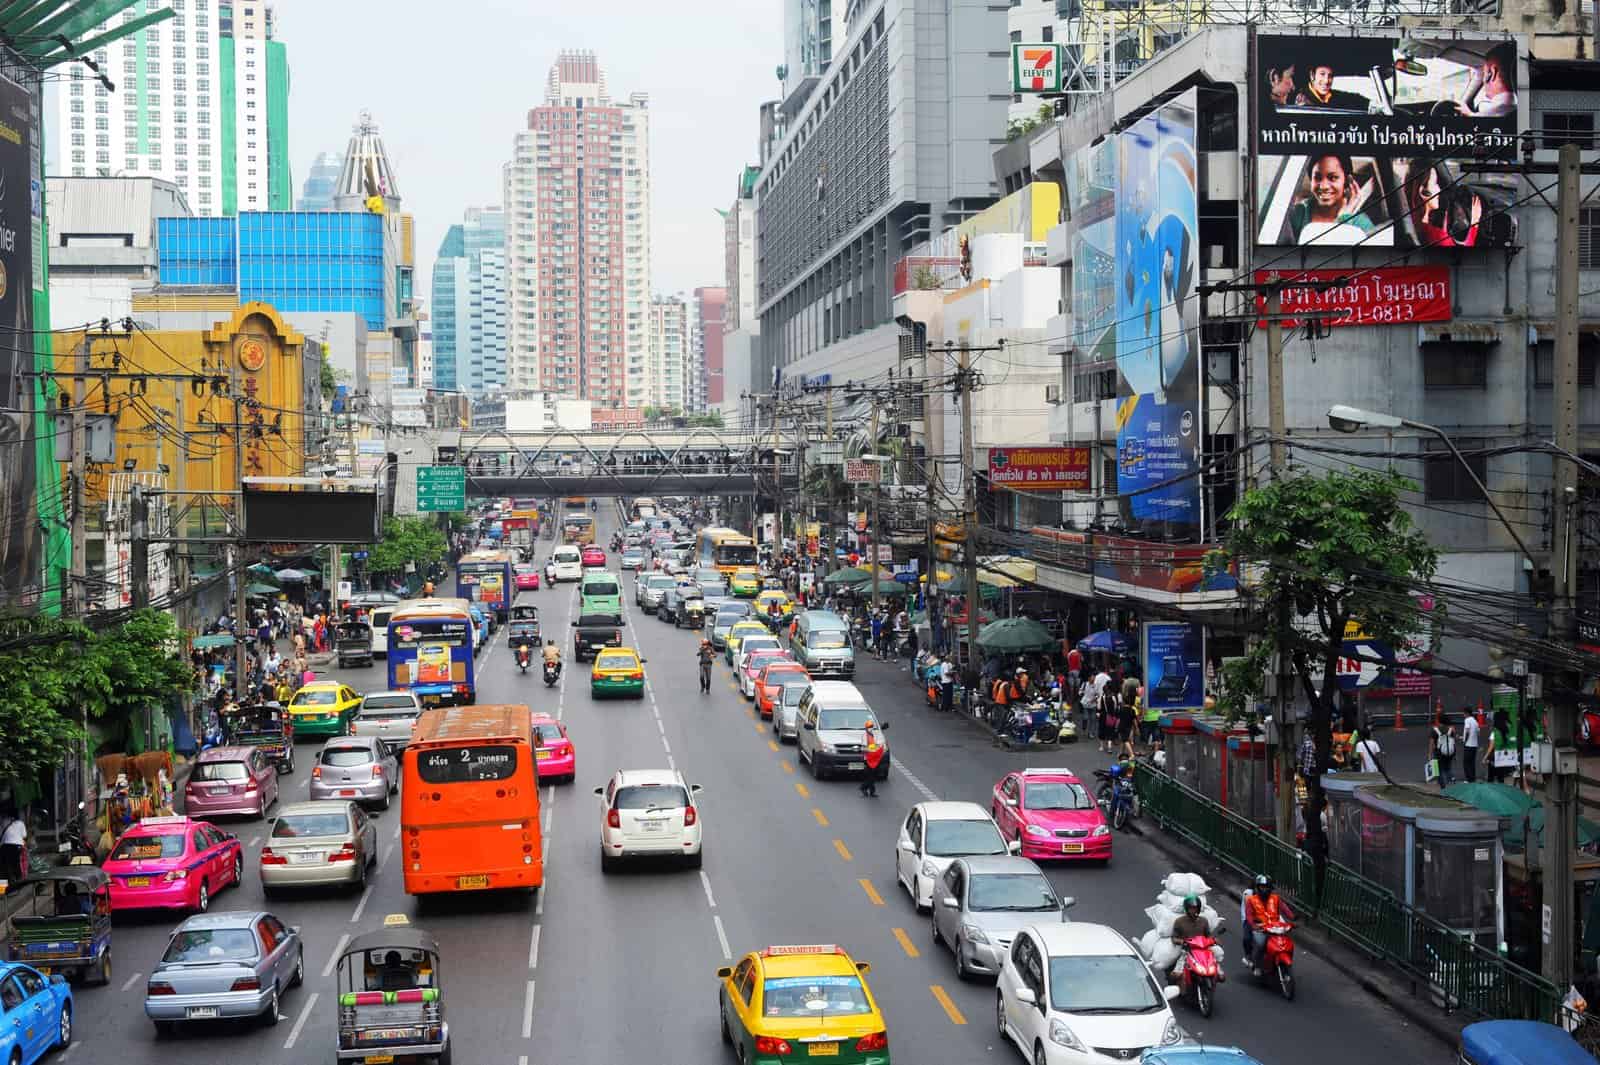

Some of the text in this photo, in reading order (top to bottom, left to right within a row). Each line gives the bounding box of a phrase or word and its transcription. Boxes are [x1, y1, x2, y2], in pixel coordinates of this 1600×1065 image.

[1024, 49, 1053, 90] 7
[1262, 124, 1368, 145] หากโทรแล้วขับ
[1074, 451, 1087, 465] 22
[460, 749, 470, 762] 2
